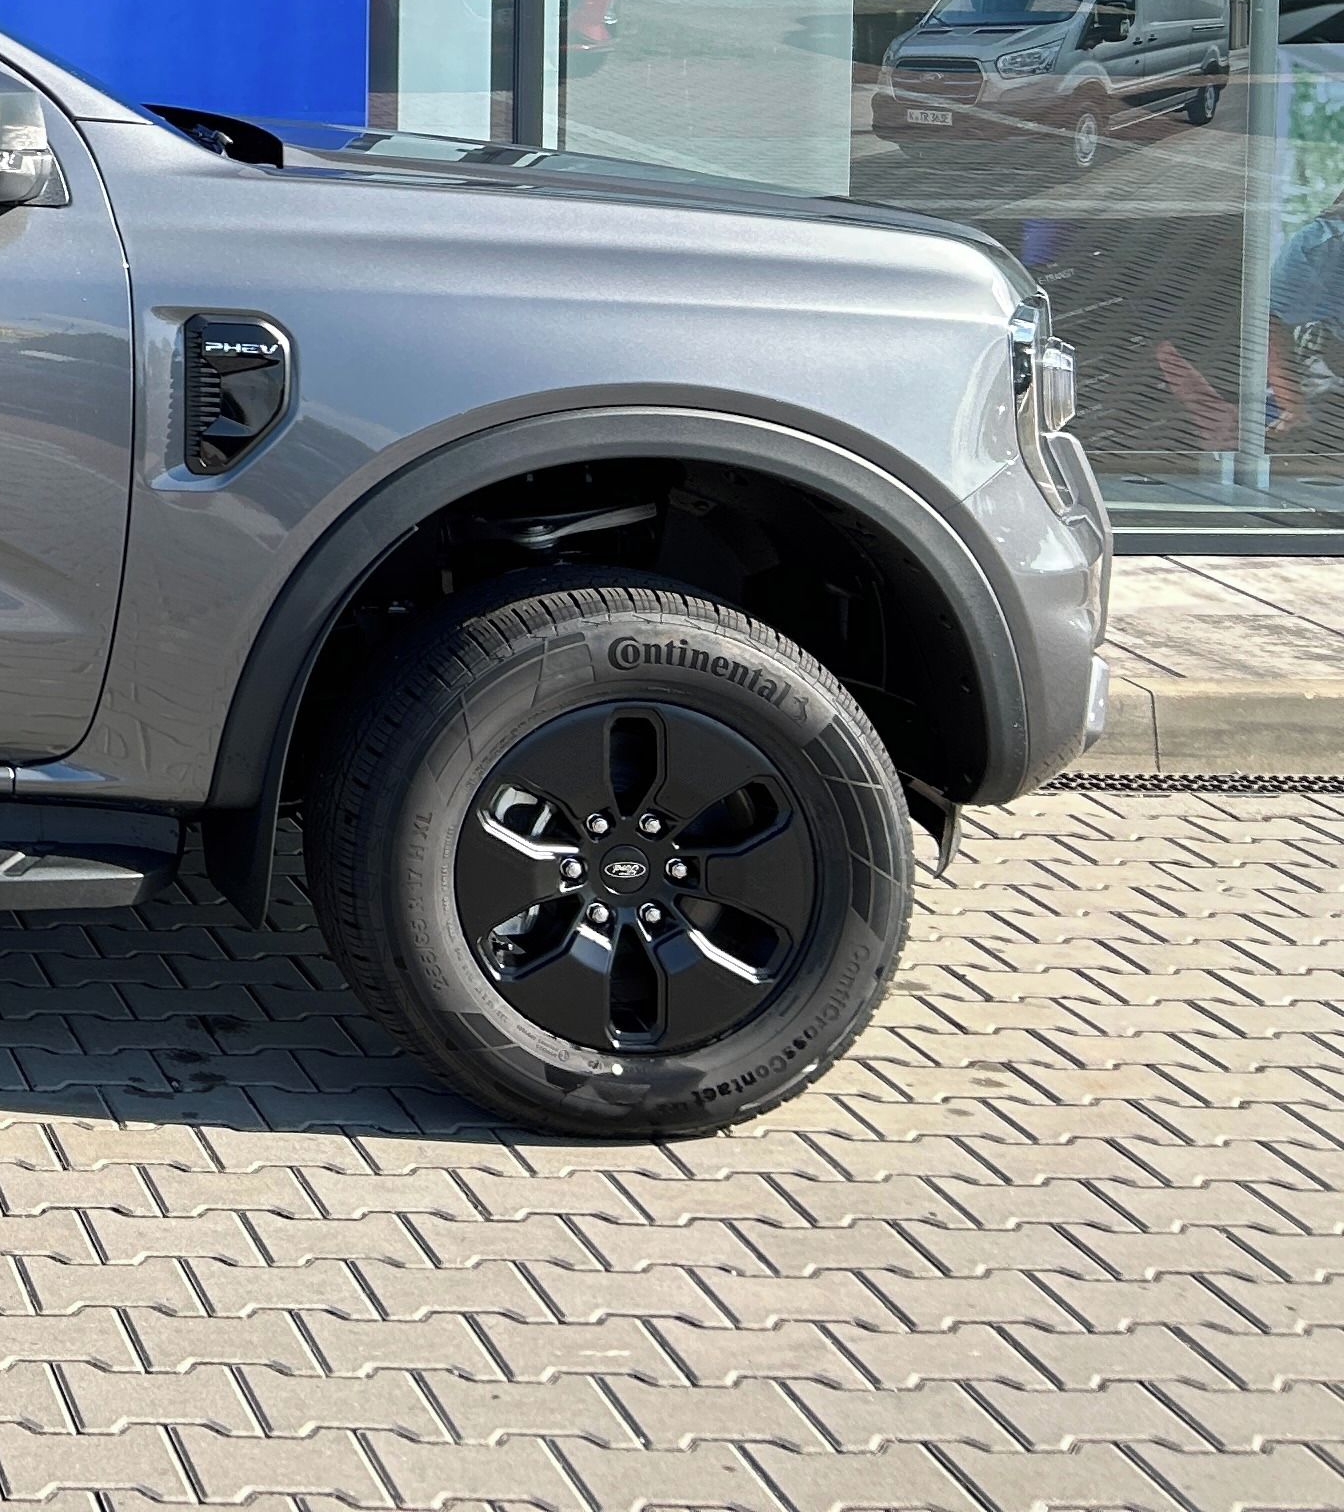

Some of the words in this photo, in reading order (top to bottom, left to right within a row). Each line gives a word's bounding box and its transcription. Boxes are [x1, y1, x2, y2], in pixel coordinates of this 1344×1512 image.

[205, 341, 278, 354] PHEV
[608, 635, 791, 709] Continental
[691, 944, 871, 1106] ContiCrossContact
